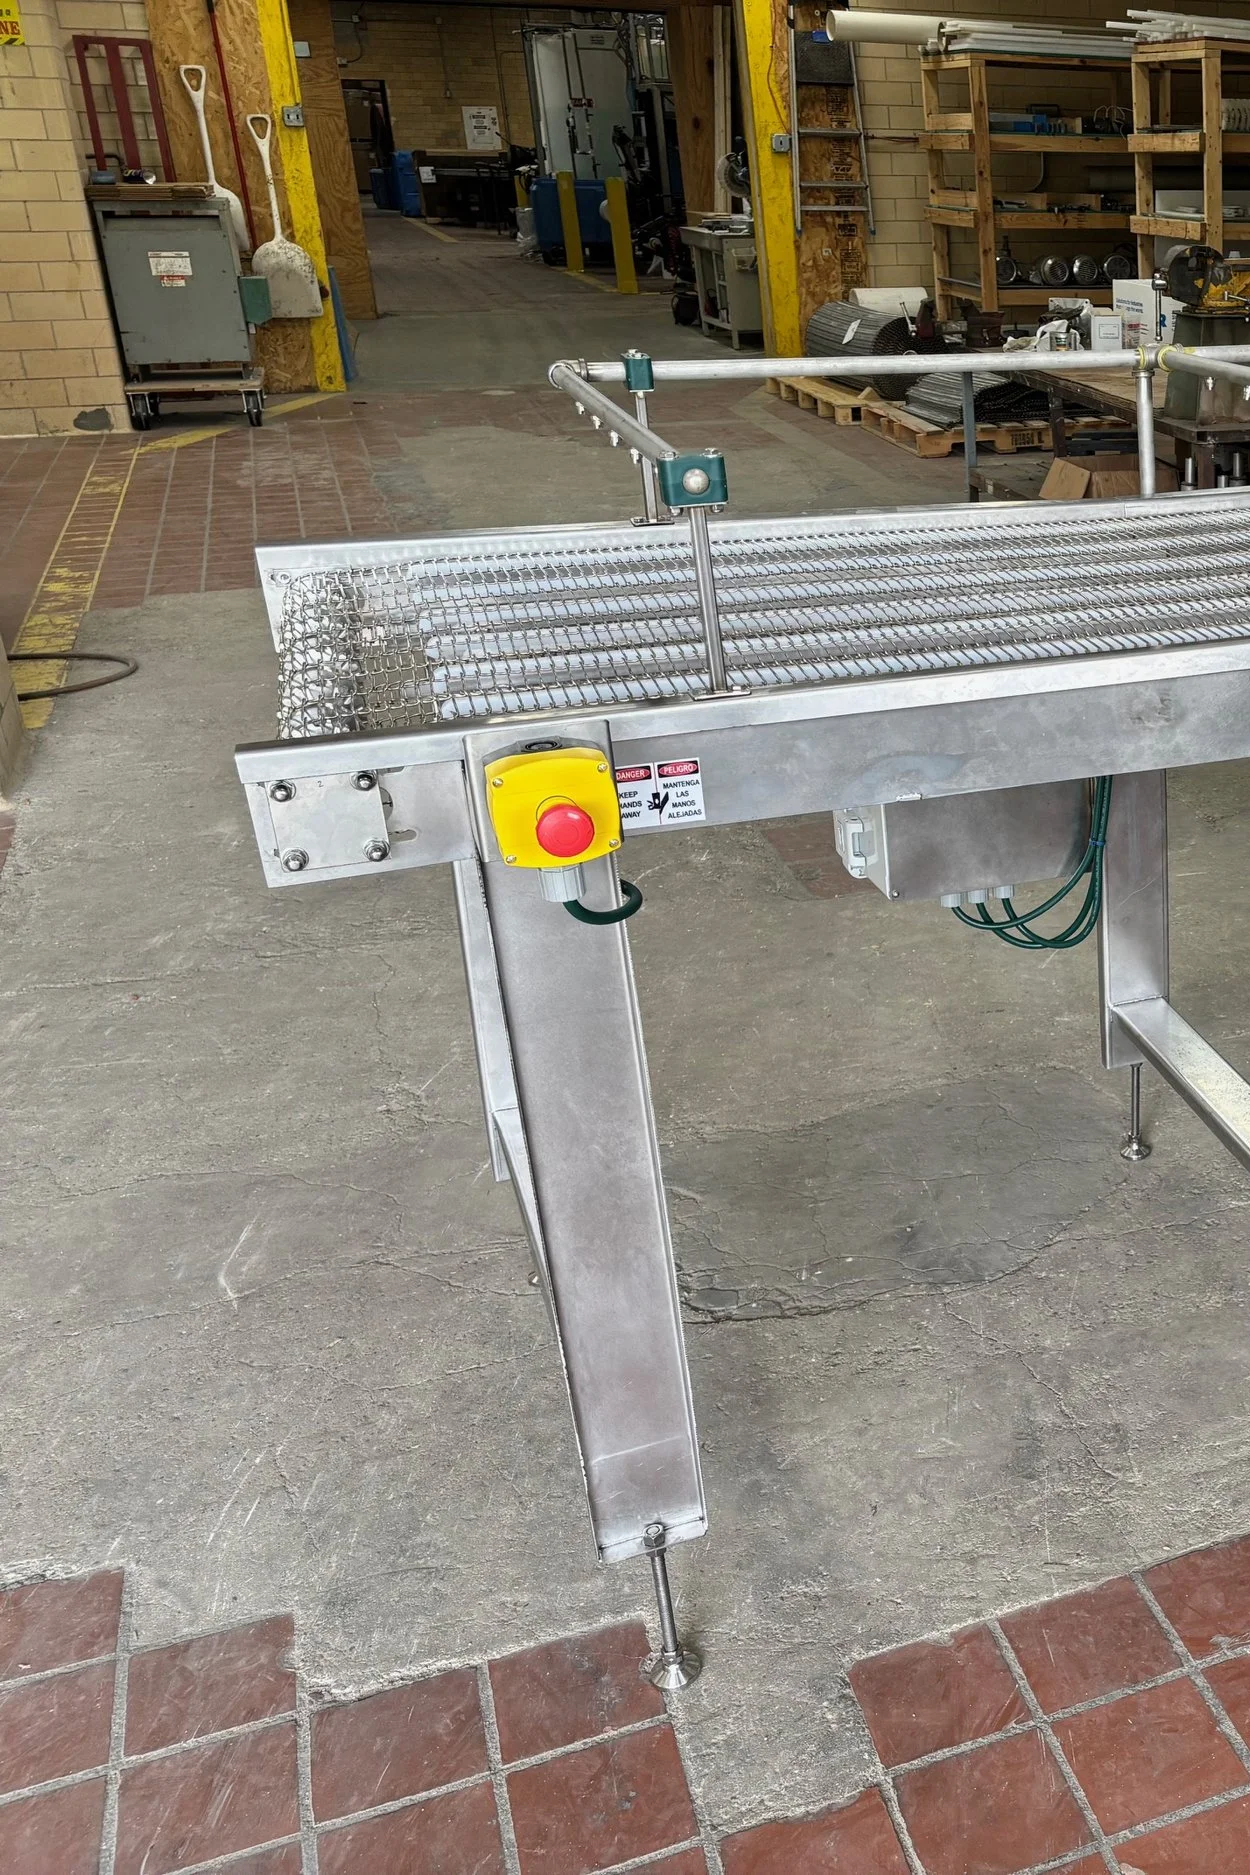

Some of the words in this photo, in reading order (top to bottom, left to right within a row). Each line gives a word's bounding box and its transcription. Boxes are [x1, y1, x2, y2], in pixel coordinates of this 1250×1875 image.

[664, 764, 694, 774] PELIGRO
[616, 770, 645, 780] DANGER
[663, 780, 700, 789] MANTENGA
[619, 791, 638, 799] KEEP
[676, 790, 689, 798] LAS
[672, 800, 696, 808] MANOS
[621, 811, 641, 819] AWAY
[667, 809, 702, 819] ALEJADAS
